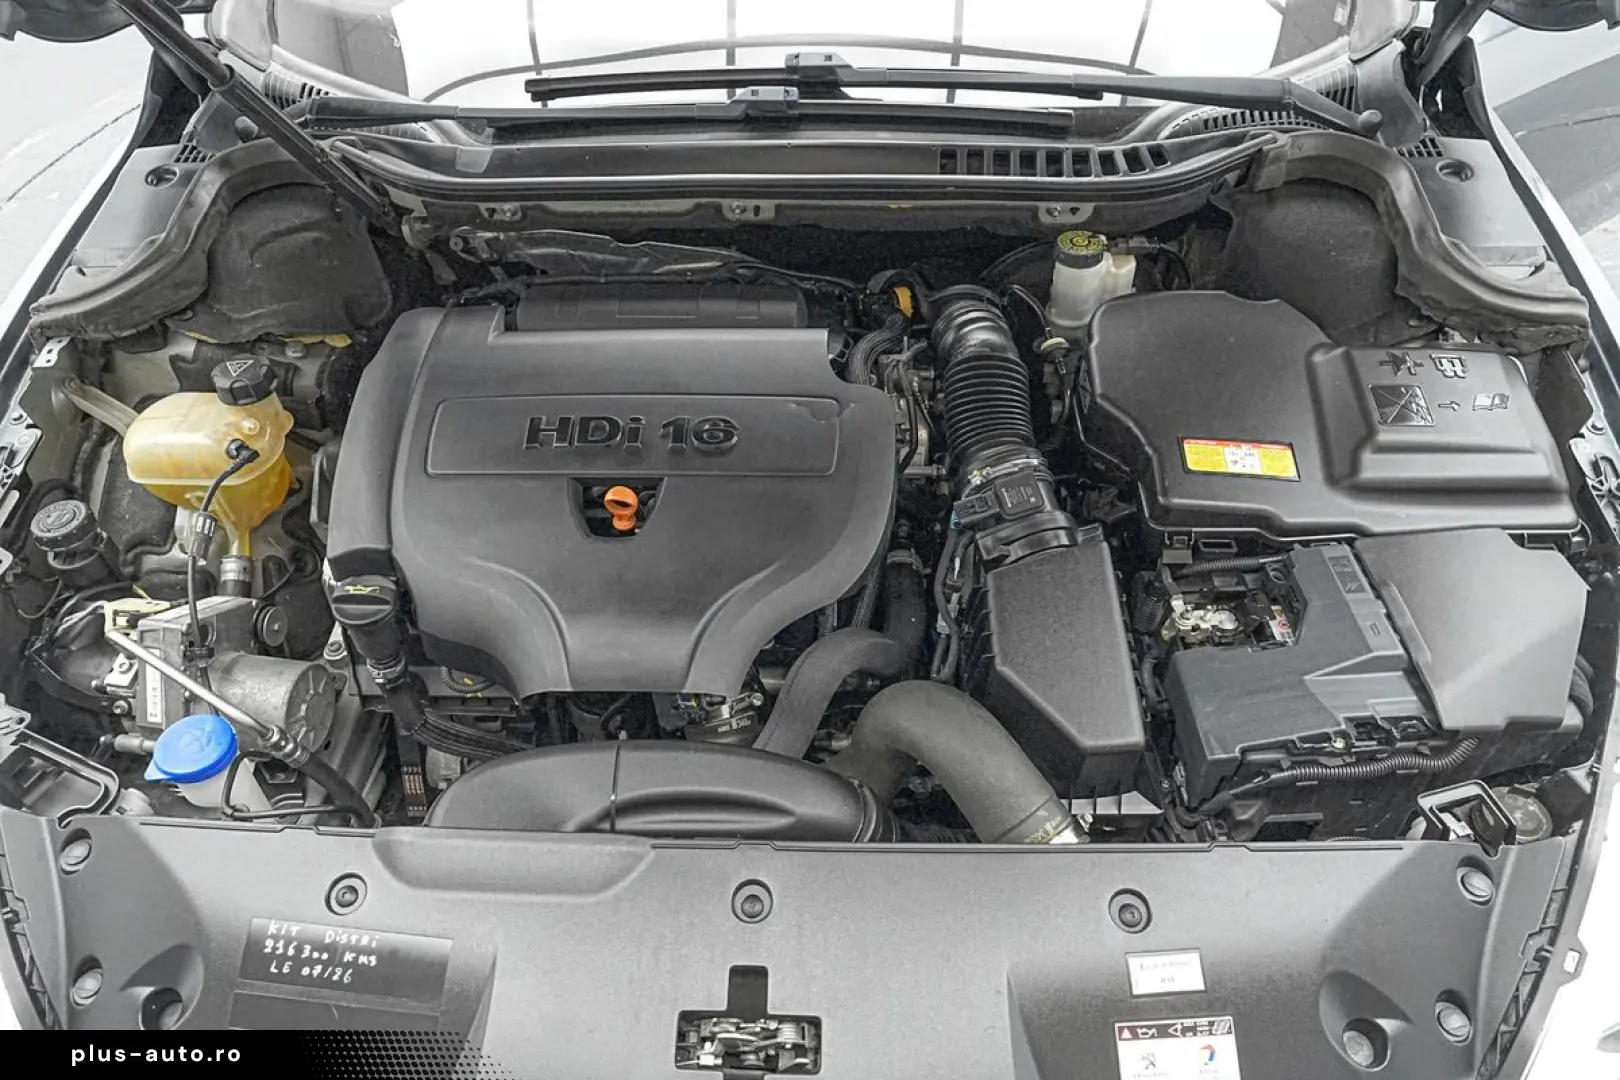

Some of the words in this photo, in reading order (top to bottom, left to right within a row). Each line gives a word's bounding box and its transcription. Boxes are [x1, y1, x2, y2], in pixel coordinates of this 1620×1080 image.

[523, 415, 646, 450] HDi
[659, 415, 740, 451] 16
[267, 918, 300, 936] KIT
[269, 959, 292, 974] LE
